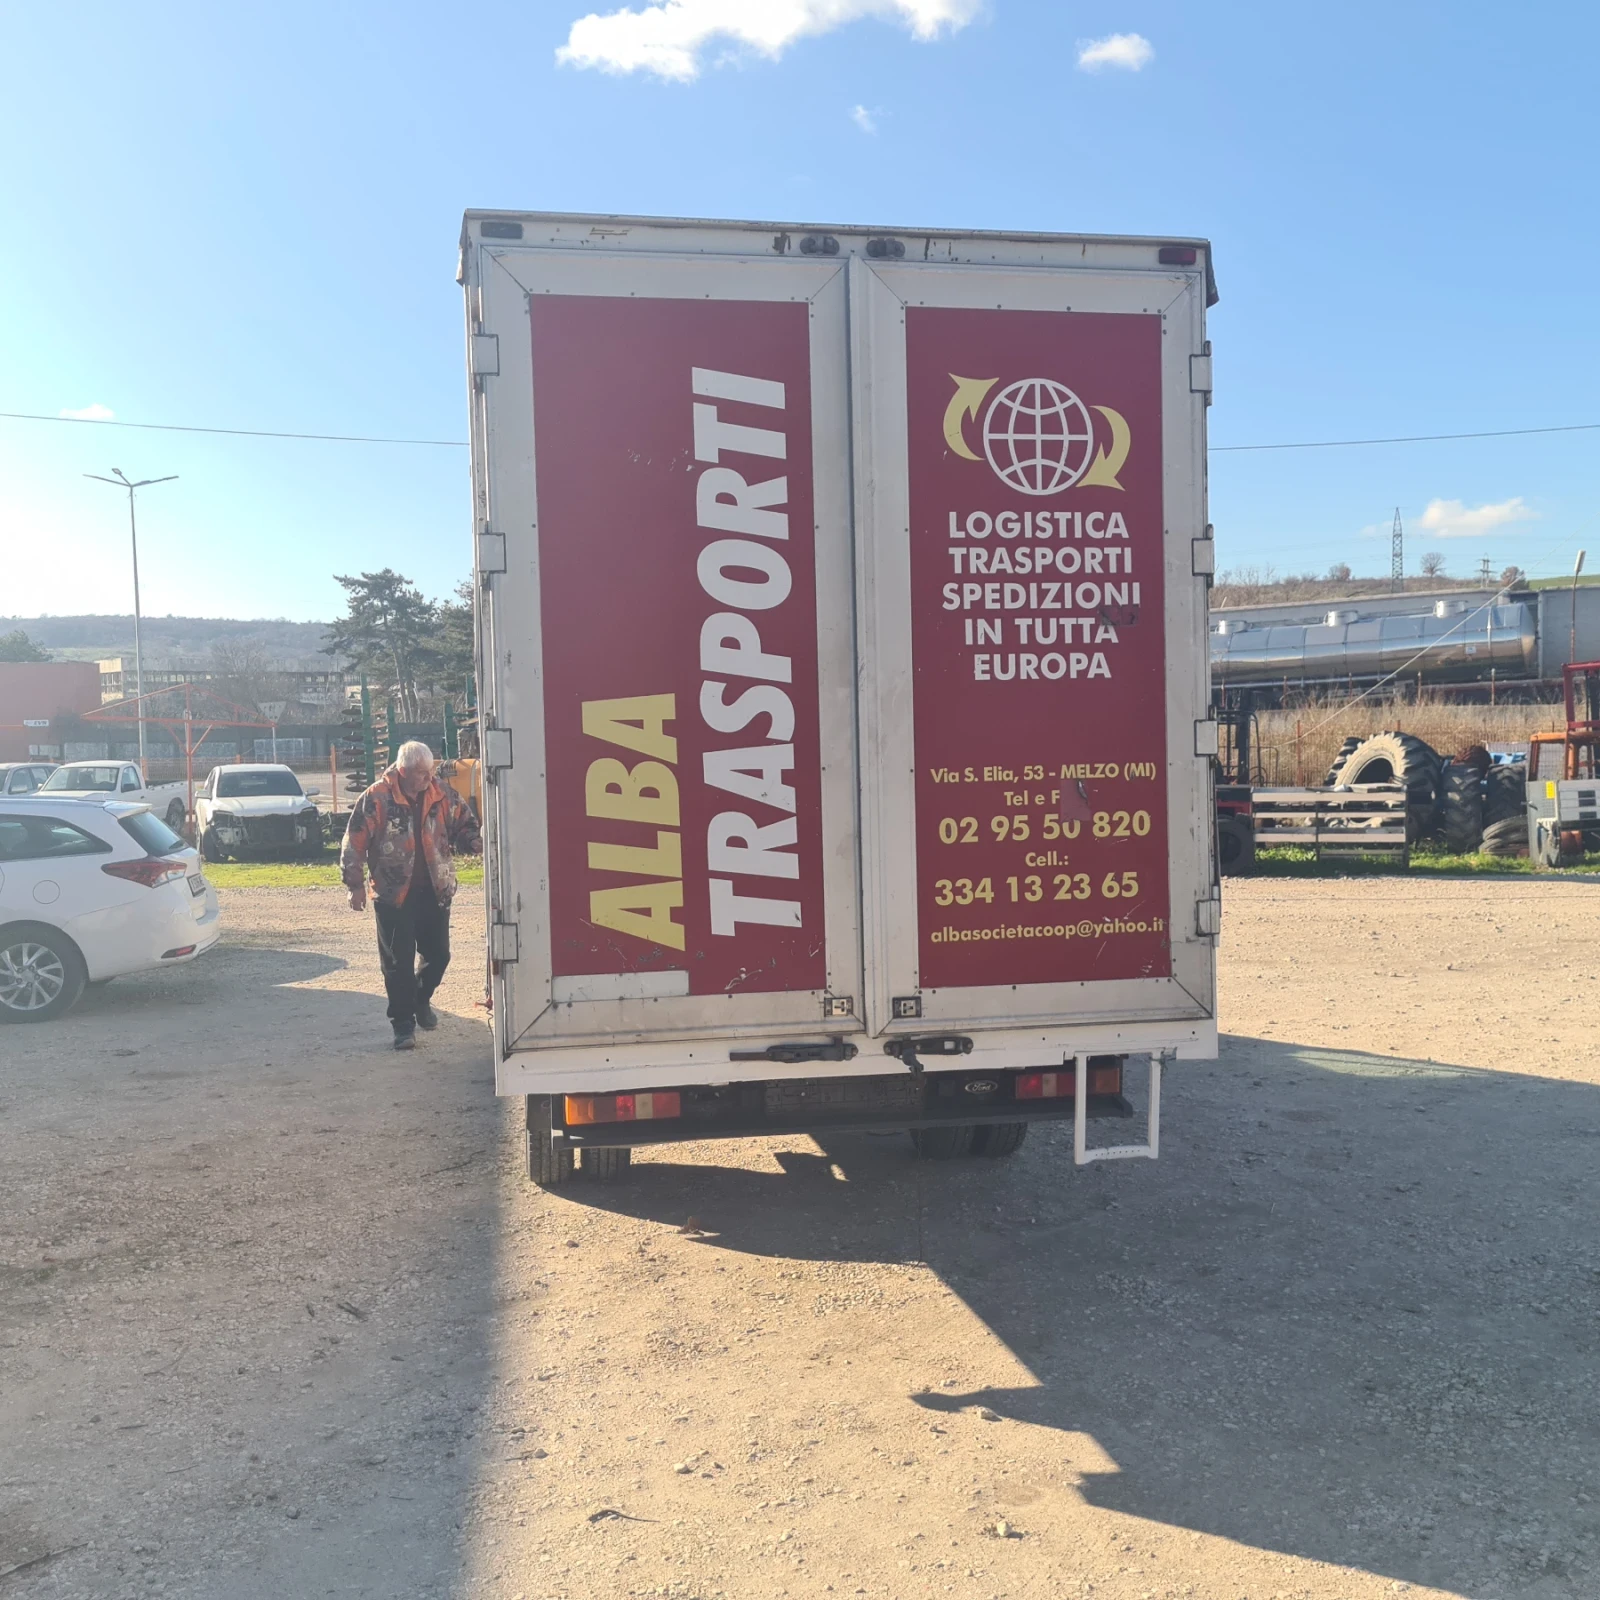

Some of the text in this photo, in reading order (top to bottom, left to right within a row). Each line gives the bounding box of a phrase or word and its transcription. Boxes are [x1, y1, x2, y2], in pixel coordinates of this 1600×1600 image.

[948, 510, 1130, 539] LOGISTICA
[948, 546, 1132, 575] TRASPORTI
[942, 581, 1141, 611] SPEDIZIONI
[964, 617, 1119, 646] IN TUTTA
[691, 366, 803, 937] TRASPORTI
[973, 652, 1112, 681] EUROPA
[930, 767, 960, 784] Via
[964, 767, 979, 783] S.
[983, 765, 1019, 784] Elia,
[1023, 764, 1045, 781] 53
[1060, 762, 1120, 780] MELZO
[1123, 761, 1157, 781] (MI)
[1003, 789, 1029, 806] Tel
[1034, 794, 1046, 806] e
[581, 692, 686, 952] ALBA
[938, 809, 1151, 845] 02 95 50 820
[1025, 850, 1069, 867] Cell.:
[934, 871, 1139, 906] 334 13 23 65
[930, 916, 1164, 943] albasocietacoop@yahoo.it
